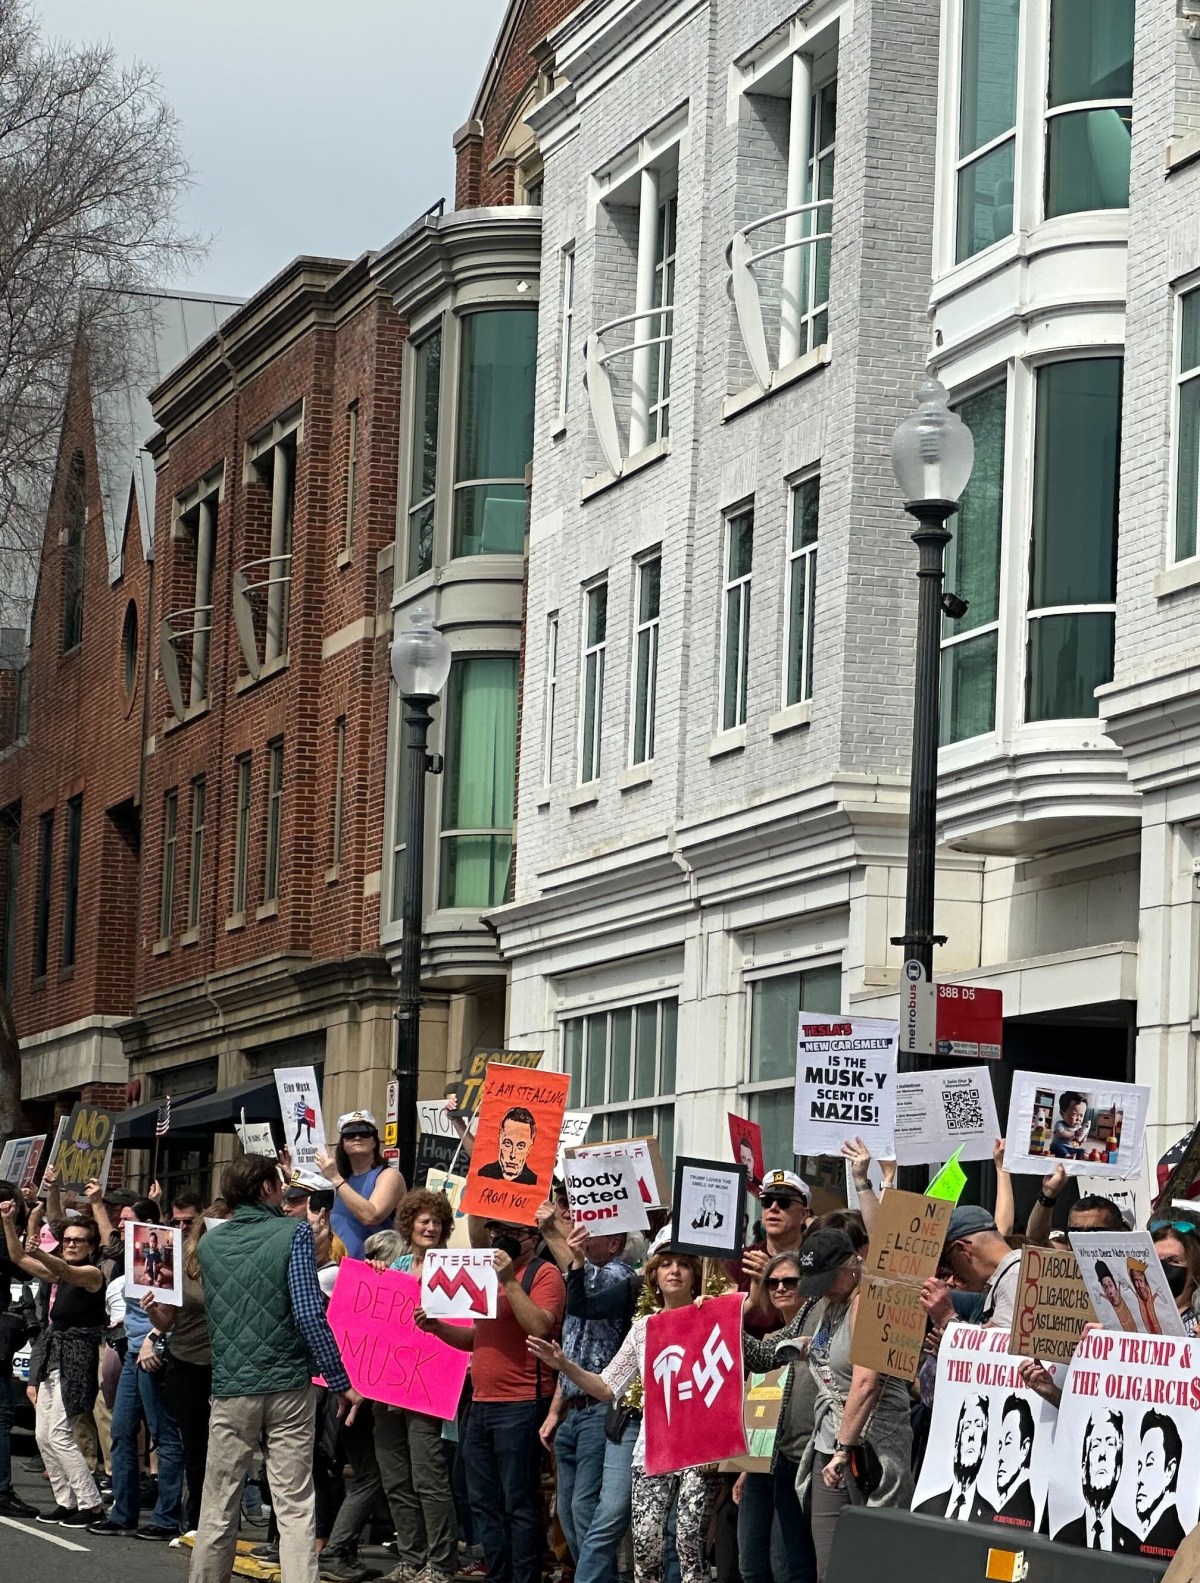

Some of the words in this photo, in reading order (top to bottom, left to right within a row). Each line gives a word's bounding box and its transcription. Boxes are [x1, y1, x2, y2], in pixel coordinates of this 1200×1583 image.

[939, 986, 958, 998] 38B
[962, 988, 975, 1000] D5
[908, 984, 917, 1049] metrobus
[802, 1023, 852, 1037] TESLA'S
[831, 1040, 852, 1051] CAR
[828, 1055, 840, 1066] IS
[844, 1057, 867, 1069] THE
[283, 1083, 295, 1094] Elon
[295, 1082, 311, 1092] Musk
[805, 1066, 887, 1089] MUSK-Y
[486, 1081, 495, 1095] I
[495, 1082, 514, 1098] AM
[517, 1087, 566, 1106] STEALING
[817, 1089, 855, 1101] SCENT
[858, 1092, 874, 1103] OF
[810, 1101, 879, 1123] NAZIS!
[72, 1109, 110, 1146] NO
[561, 1119, 588, 1136] HESE
[567, 1172, 623, 1189] obody
[479, 1187, 508, 1208] FROM
[508, 1194, 530, 1209] YOU
[570, 1187, 629, 1206] ected
[925, 1203, 945, 1221] NO
[910, 1217, 940, 1236] ONE
[885, 1233, 940, 1258] ELECTED
[1078, 1249, 1090, 1258] Who
[1112, 1249, 1125, 1258] Nuts
[440, 1255, 492, 1267] TESLA
[877, 1251, 922, 1277] ELON
[867, 1284, 920, 1309] MASSIVE
[1025, 1281, 1090, 1312] OLIGARCHS
[354, 1281, 437, 1338] DEPO
[876, 1304, 924, 1330] UNJUST
[950, 1328, 987, 1351] STOP
[1019, 1335, 1079, 1358] EVERYONE
[887, 1348, 916, 1374] KILLS
[1076, 1336, 1115, 1361] STOP
[1119, 1337, 1176, 1368] TRUMP
[1179, 1344, 1192, 1369] &
[340, 1331, 439, 1405] MUSK
[947, 1359, 972, 1384] THE
[1071, 1369, 1100, 1397] THE
